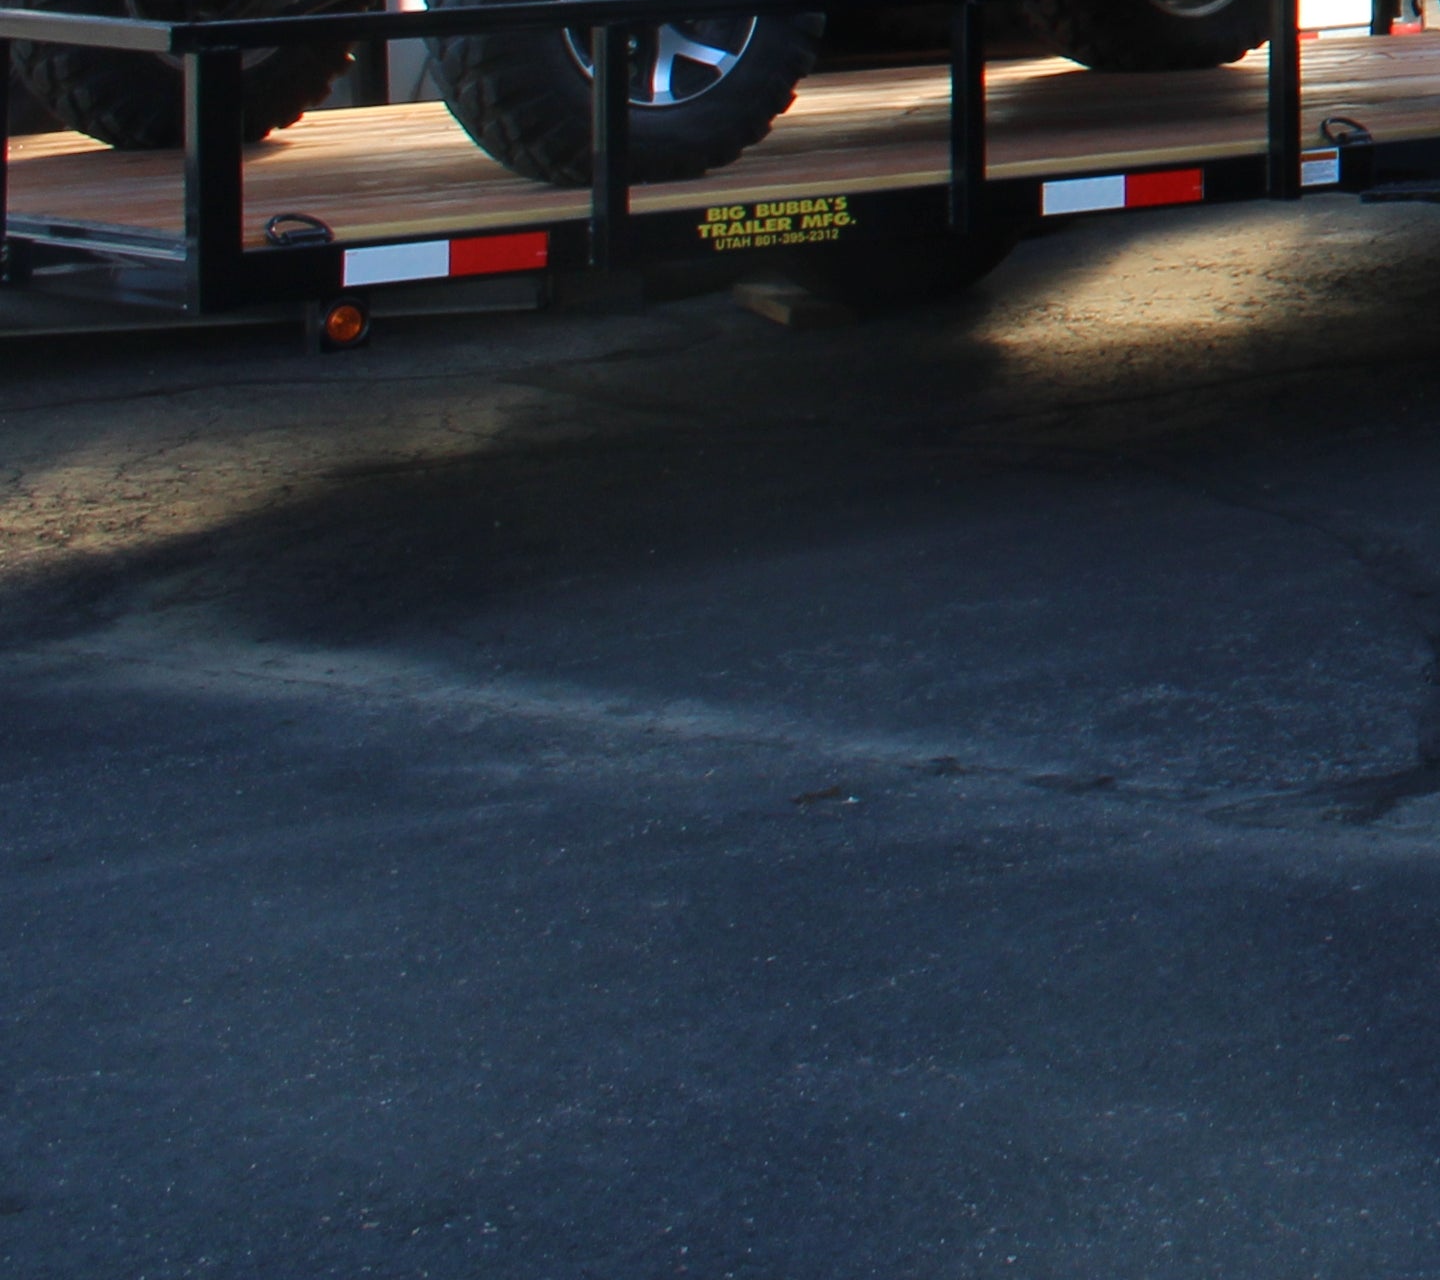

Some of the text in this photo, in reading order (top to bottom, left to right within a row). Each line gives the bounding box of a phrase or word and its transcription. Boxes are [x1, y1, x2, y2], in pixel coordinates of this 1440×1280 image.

[706, 196, 848, 222] BIG BUBBA'S
[698, 212, 857, 238] TRAILER MFG.
[715, 228, 840, 251] UTAH 801-395-2312
